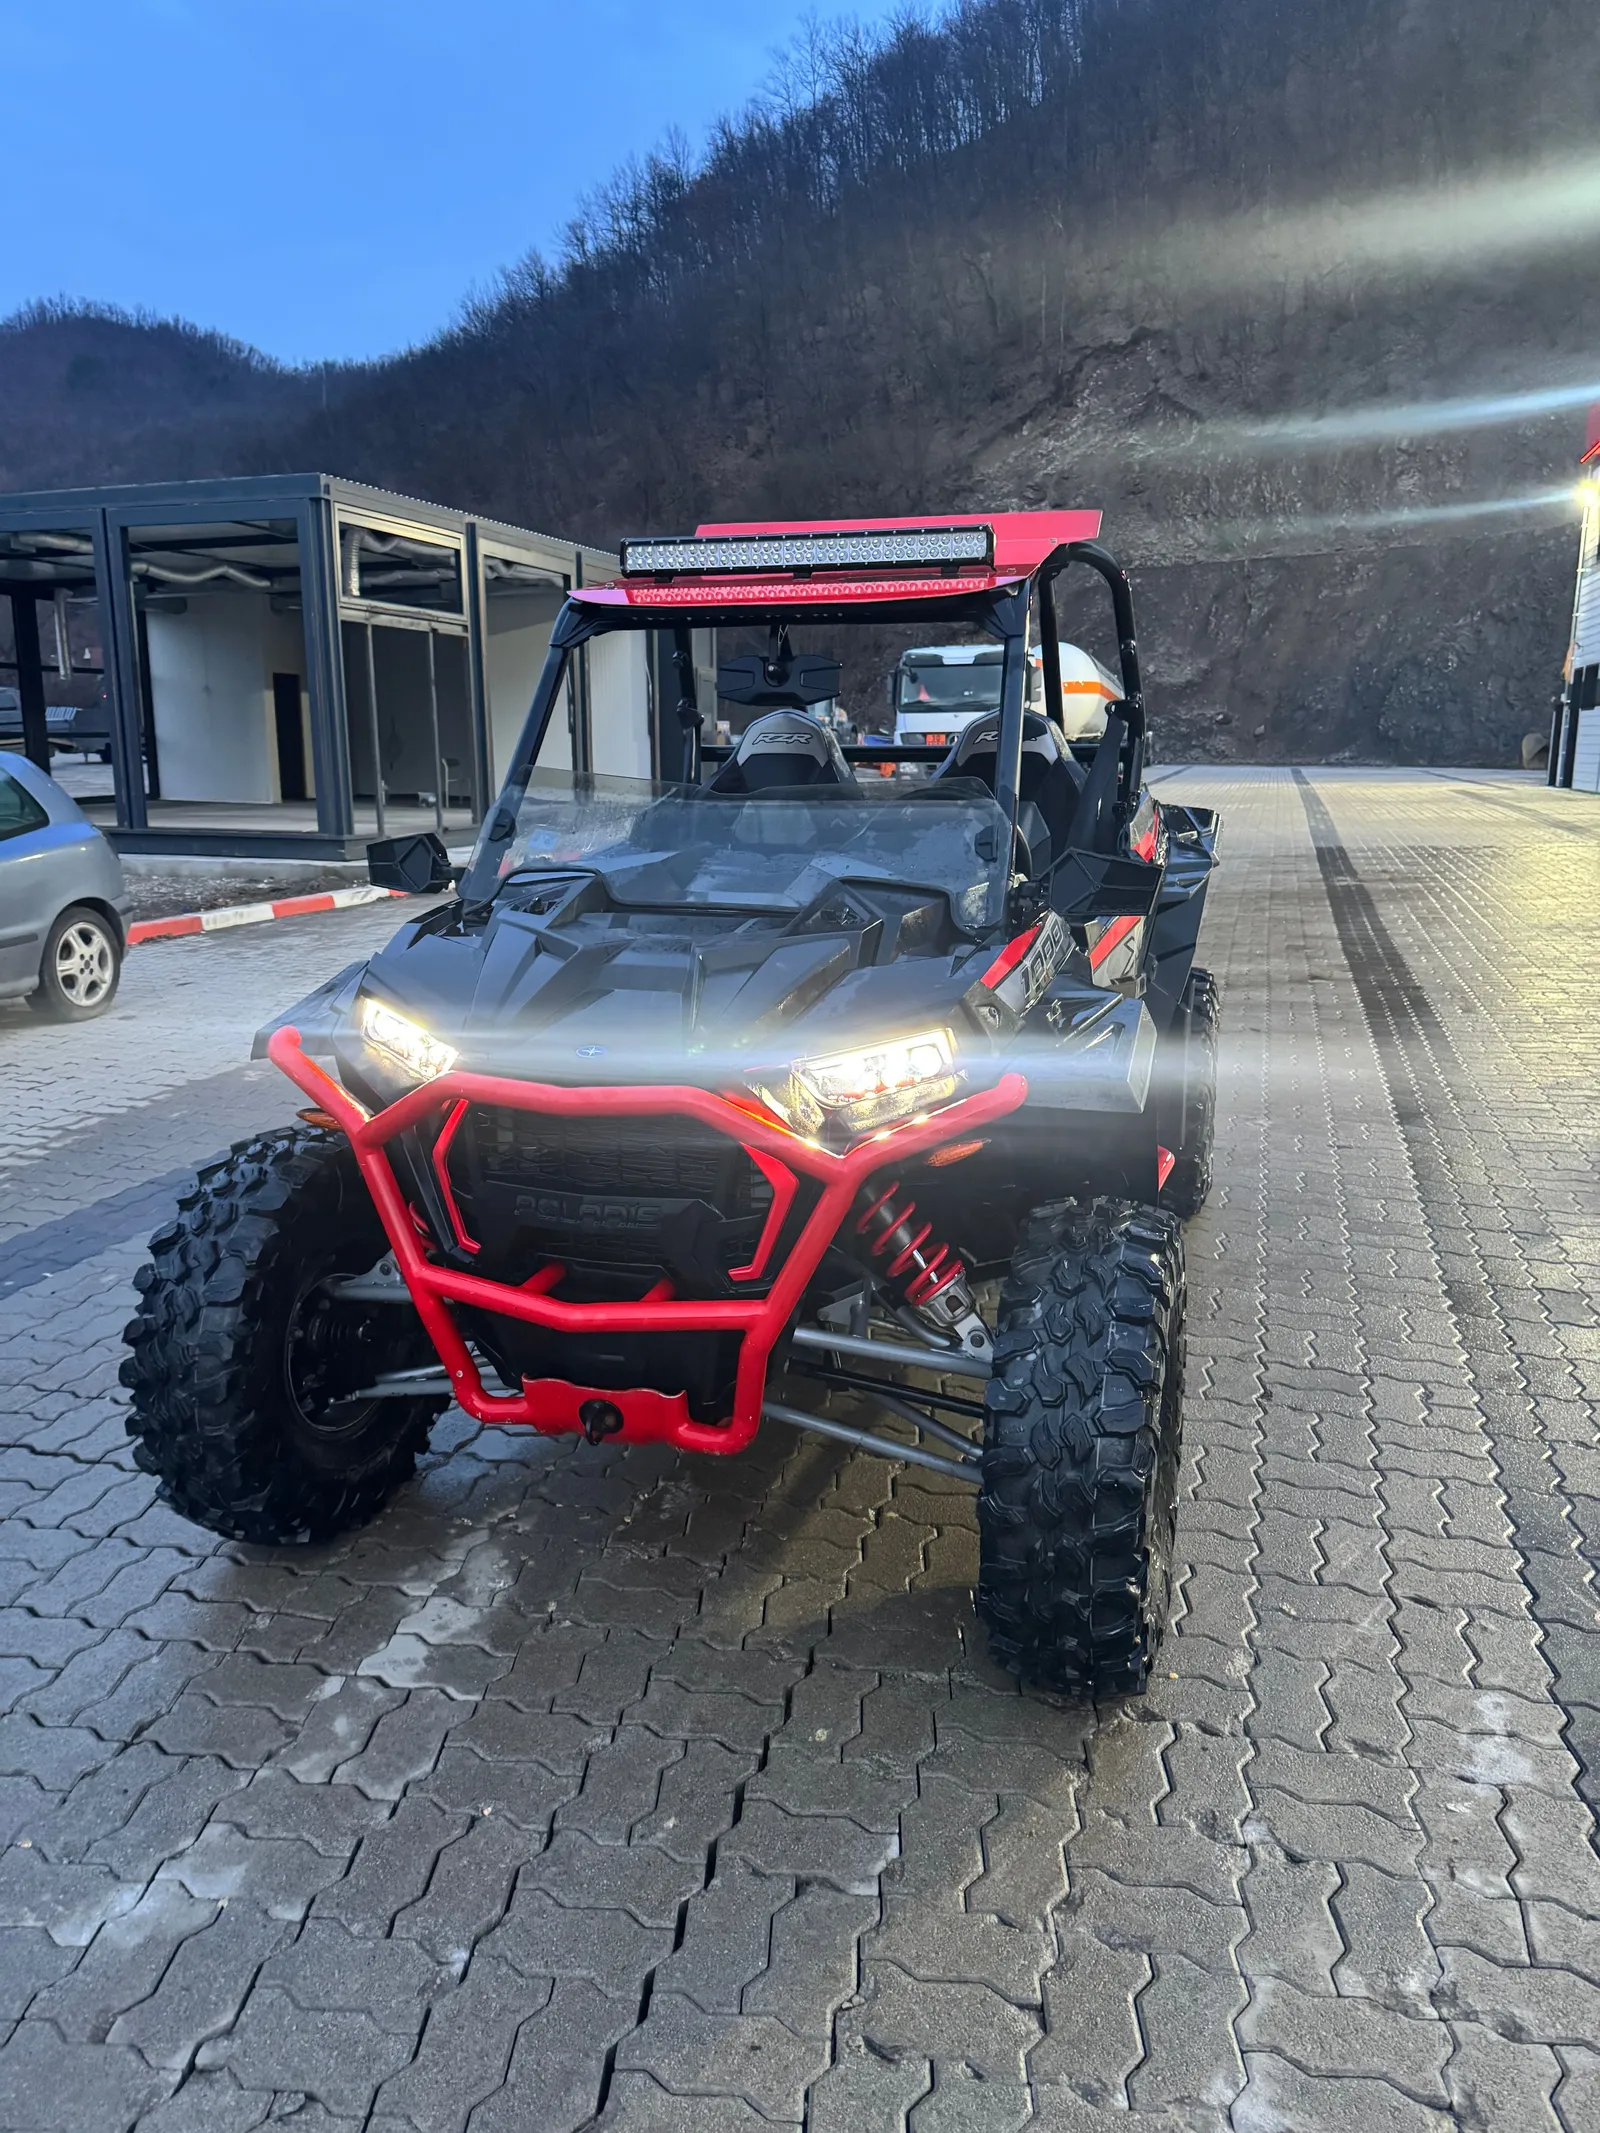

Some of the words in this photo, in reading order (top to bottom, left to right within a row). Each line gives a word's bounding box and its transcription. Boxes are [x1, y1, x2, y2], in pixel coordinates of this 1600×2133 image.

[752, 732, 813, 745] RZR
[1020, 917, 1063, 998] 1000
[514, 1194, 662, 1228] POLARIS
